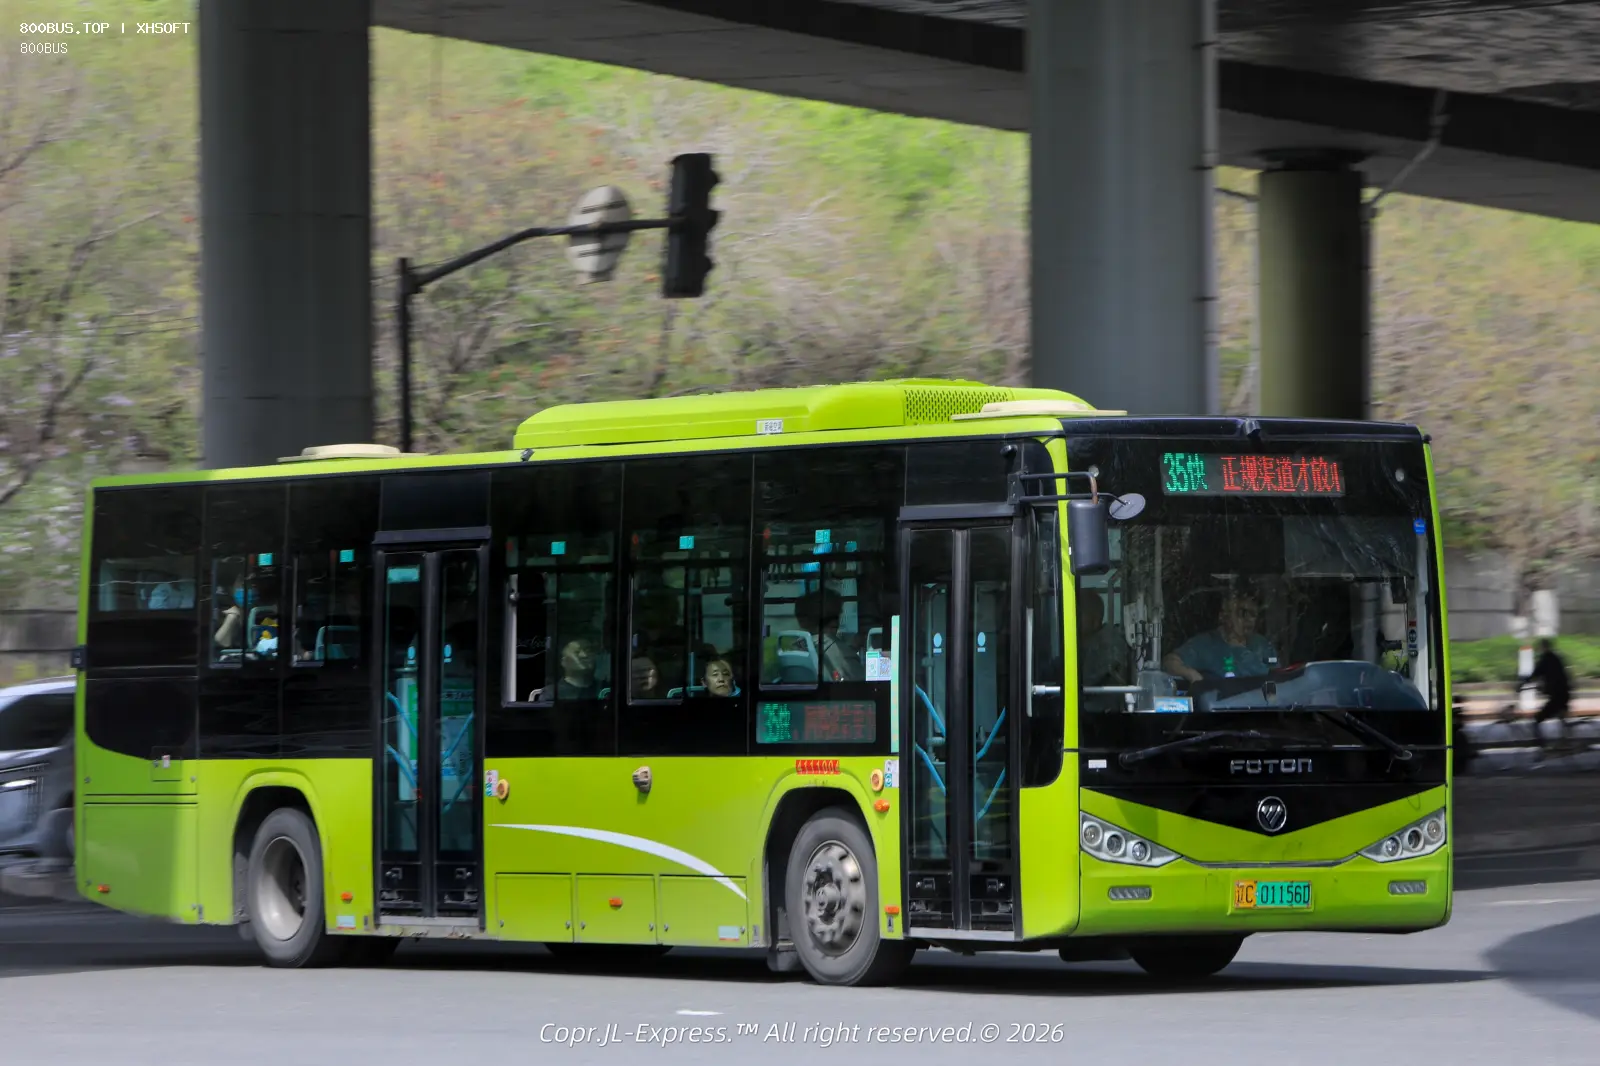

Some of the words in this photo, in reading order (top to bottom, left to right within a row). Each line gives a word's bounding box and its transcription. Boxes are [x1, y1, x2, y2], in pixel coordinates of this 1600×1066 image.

[1163, 452, 1208, 493] 35快
[1229, 758, 1313, 775] FOTON
[1260, 884, 1311, 905] 01156D
